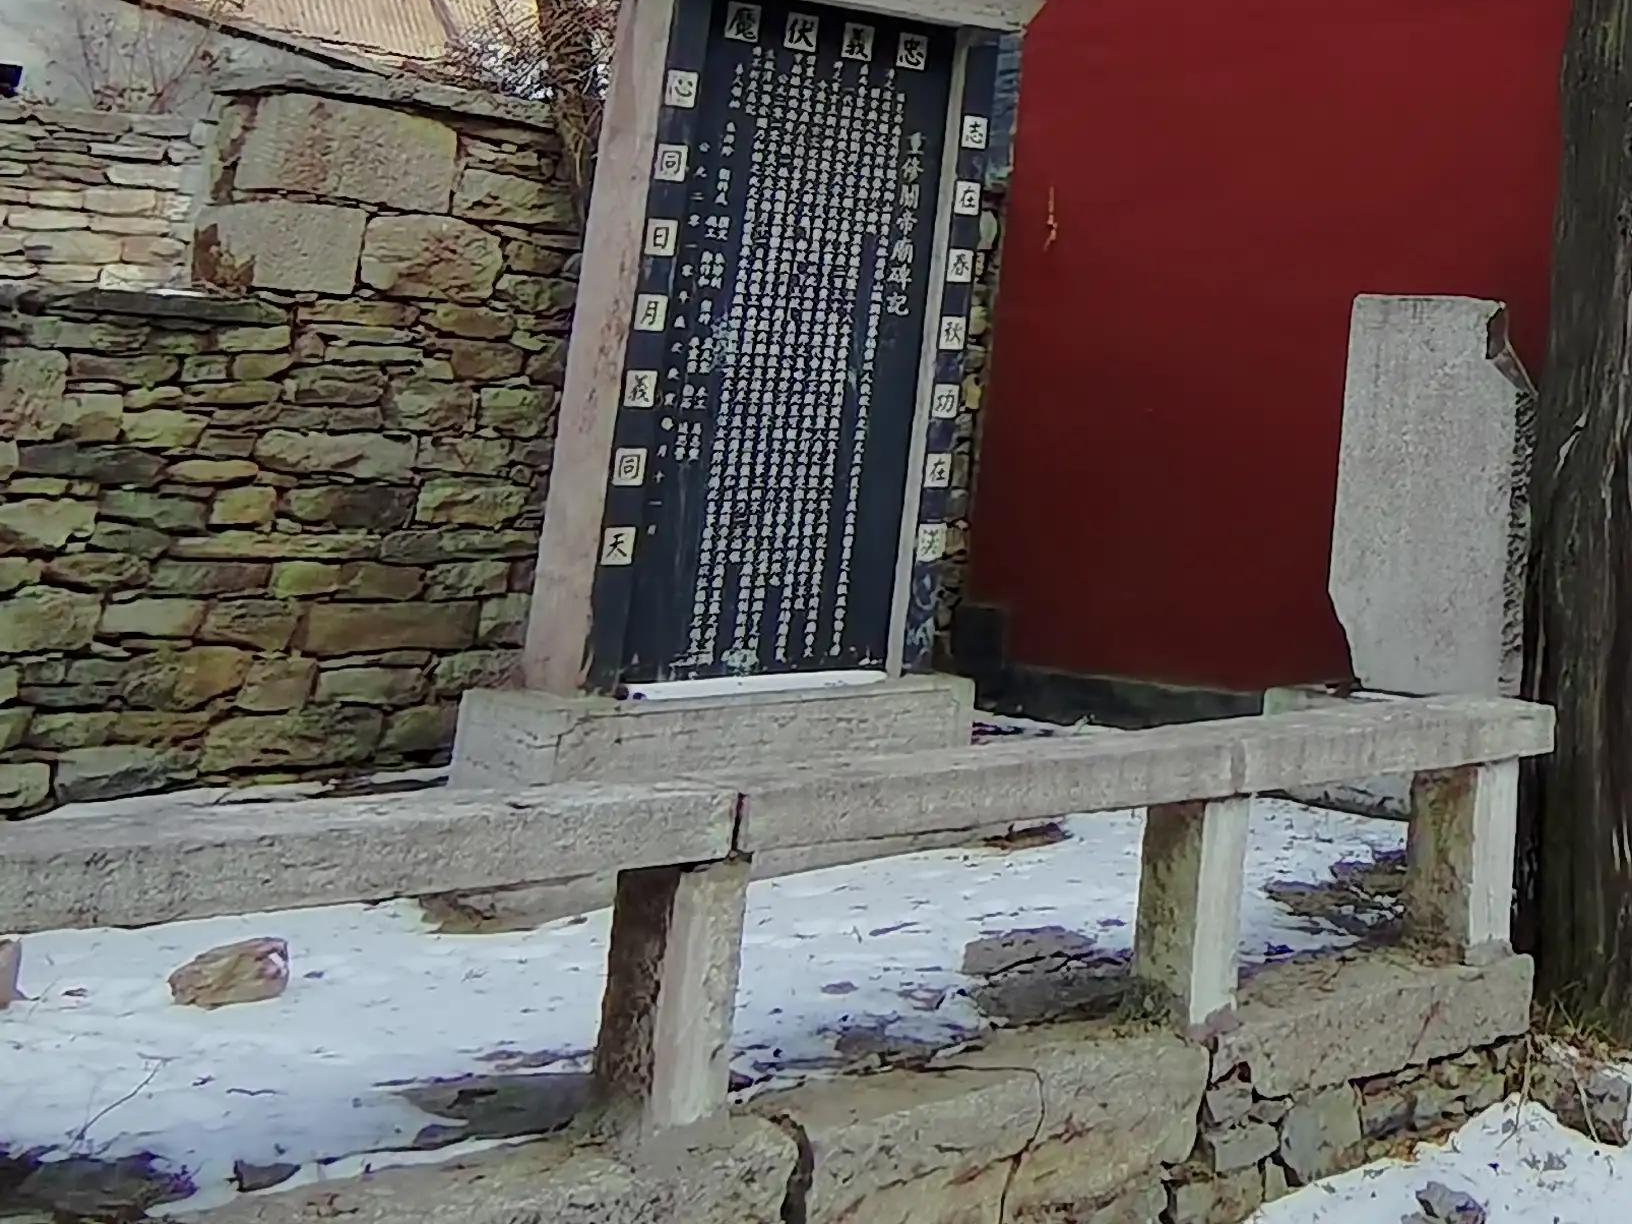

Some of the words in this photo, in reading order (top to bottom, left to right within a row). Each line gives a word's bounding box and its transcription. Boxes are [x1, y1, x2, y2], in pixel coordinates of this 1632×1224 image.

[606, 77, 694, 558] 心同日月義同天
